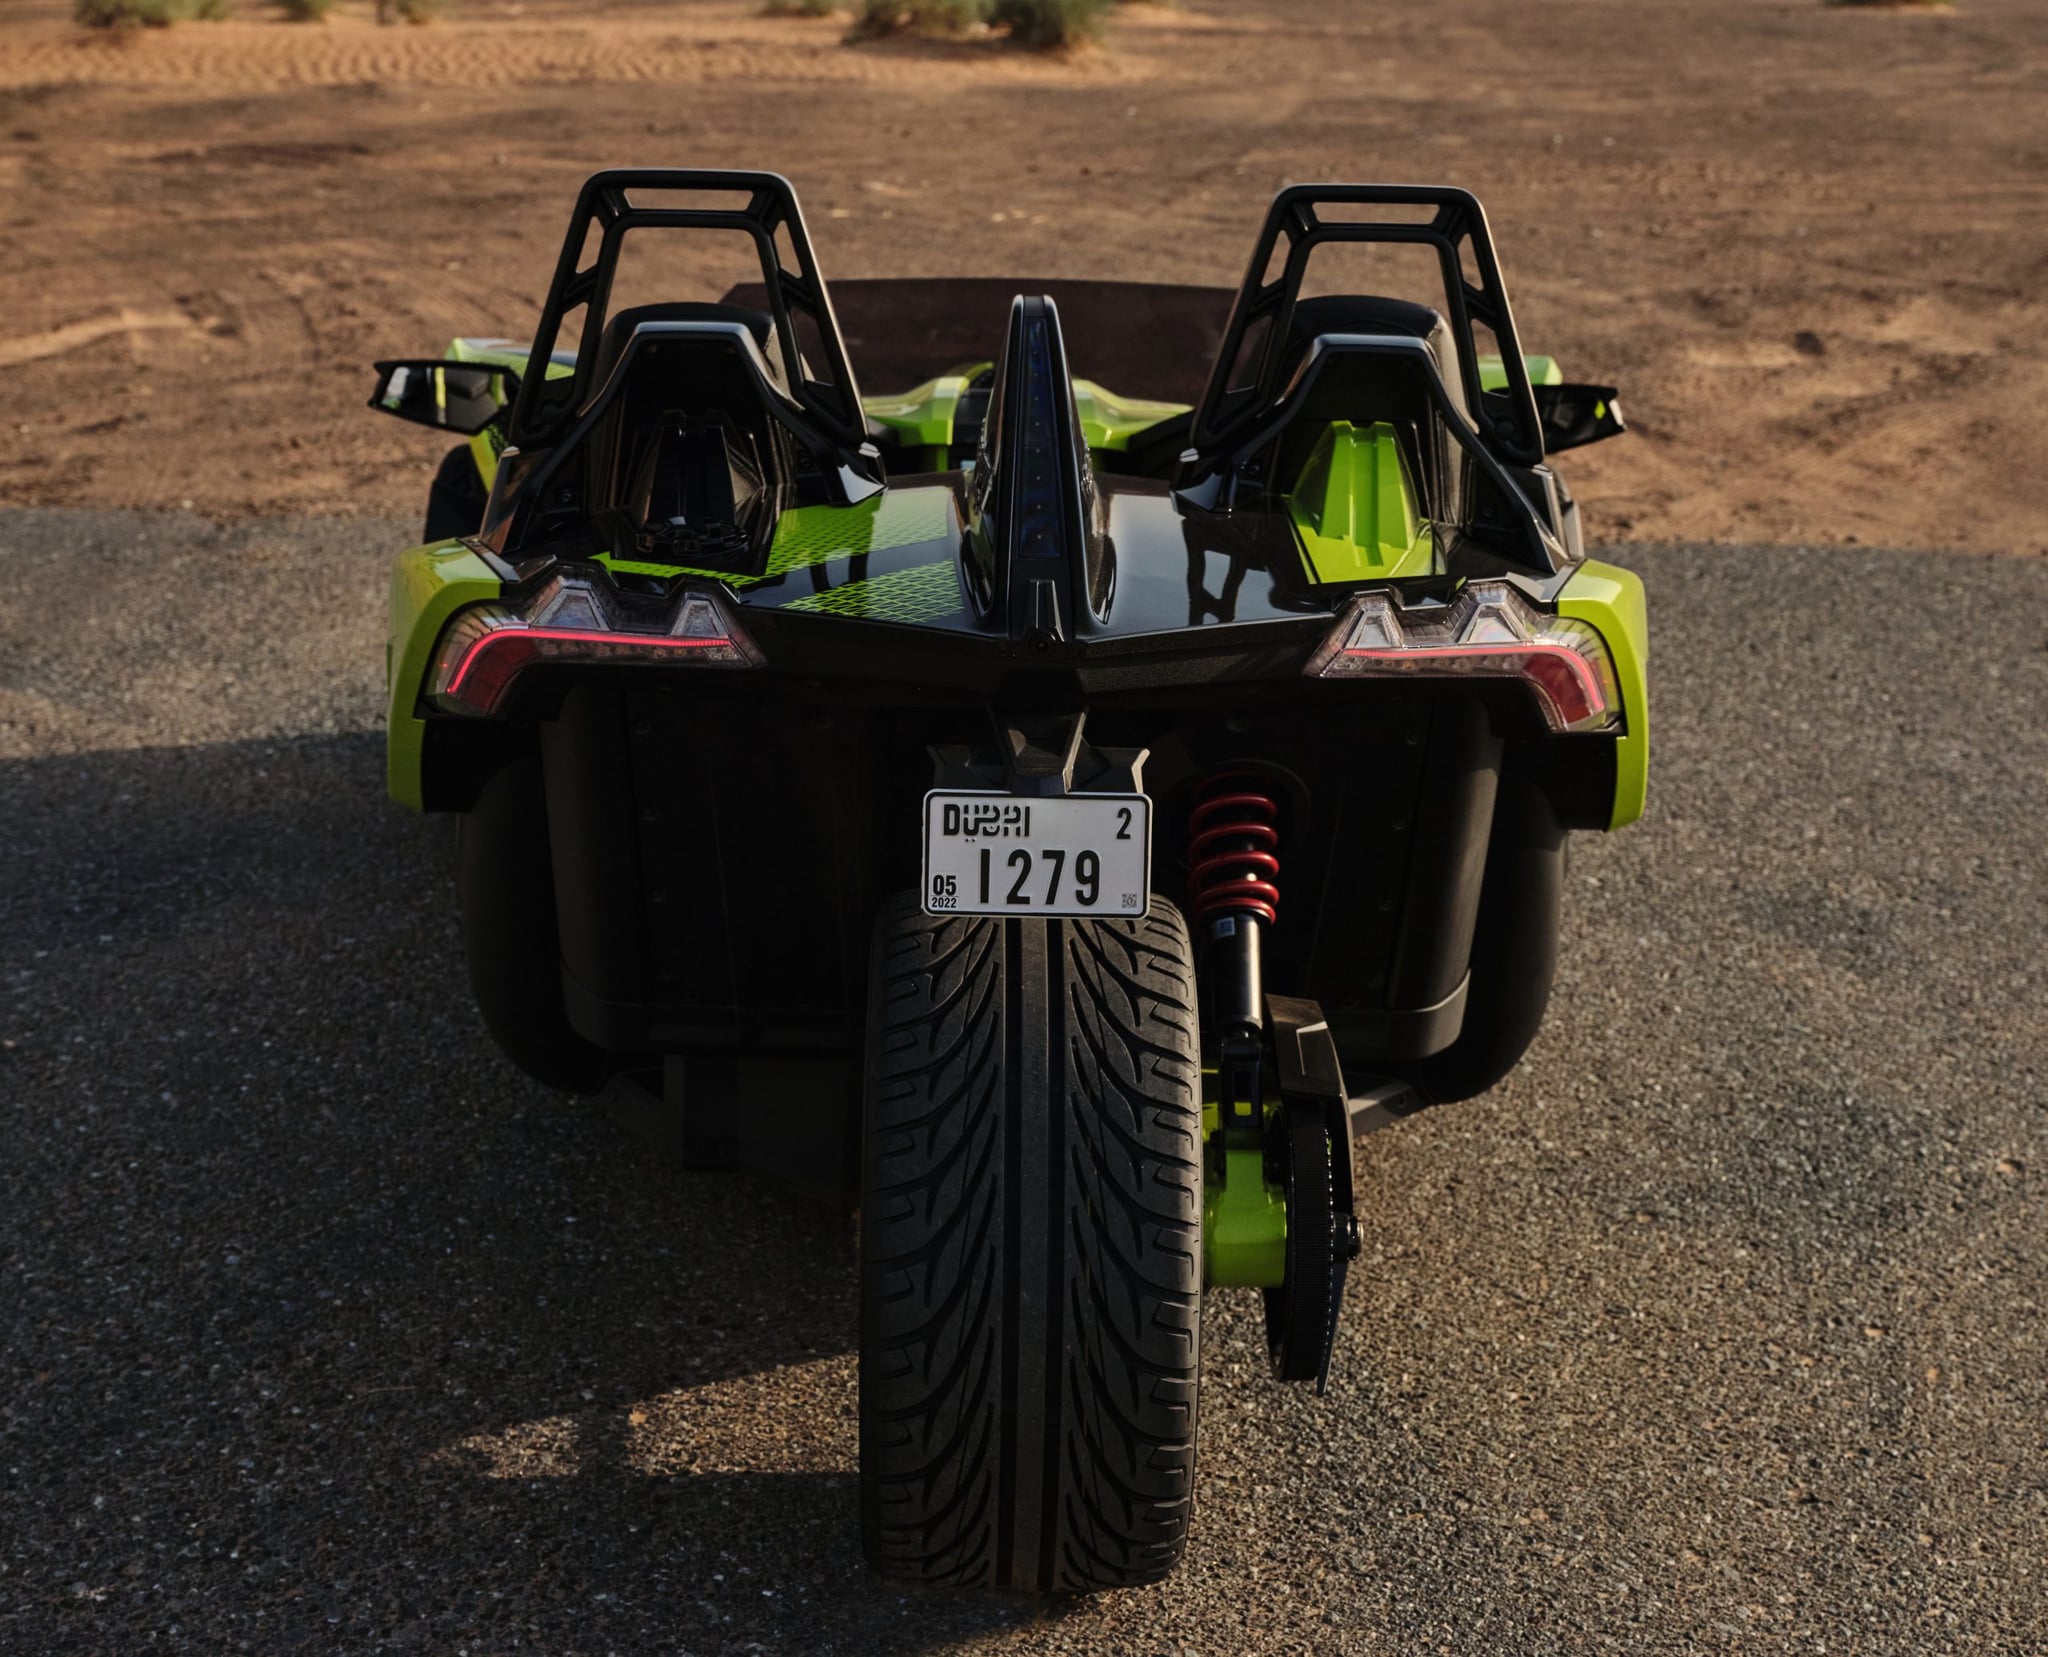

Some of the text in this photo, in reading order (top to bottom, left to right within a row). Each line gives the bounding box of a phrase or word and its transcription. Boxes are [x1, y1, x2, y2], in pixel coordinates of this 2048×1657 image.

[943, 803, 1031, 839] DUBAI
[1117, 807, 1132, 840] 2
[932, 874, 957, 896] 05
[979, 848, 1100, 907] 1279
[931, 896, 957, 909] 2022
